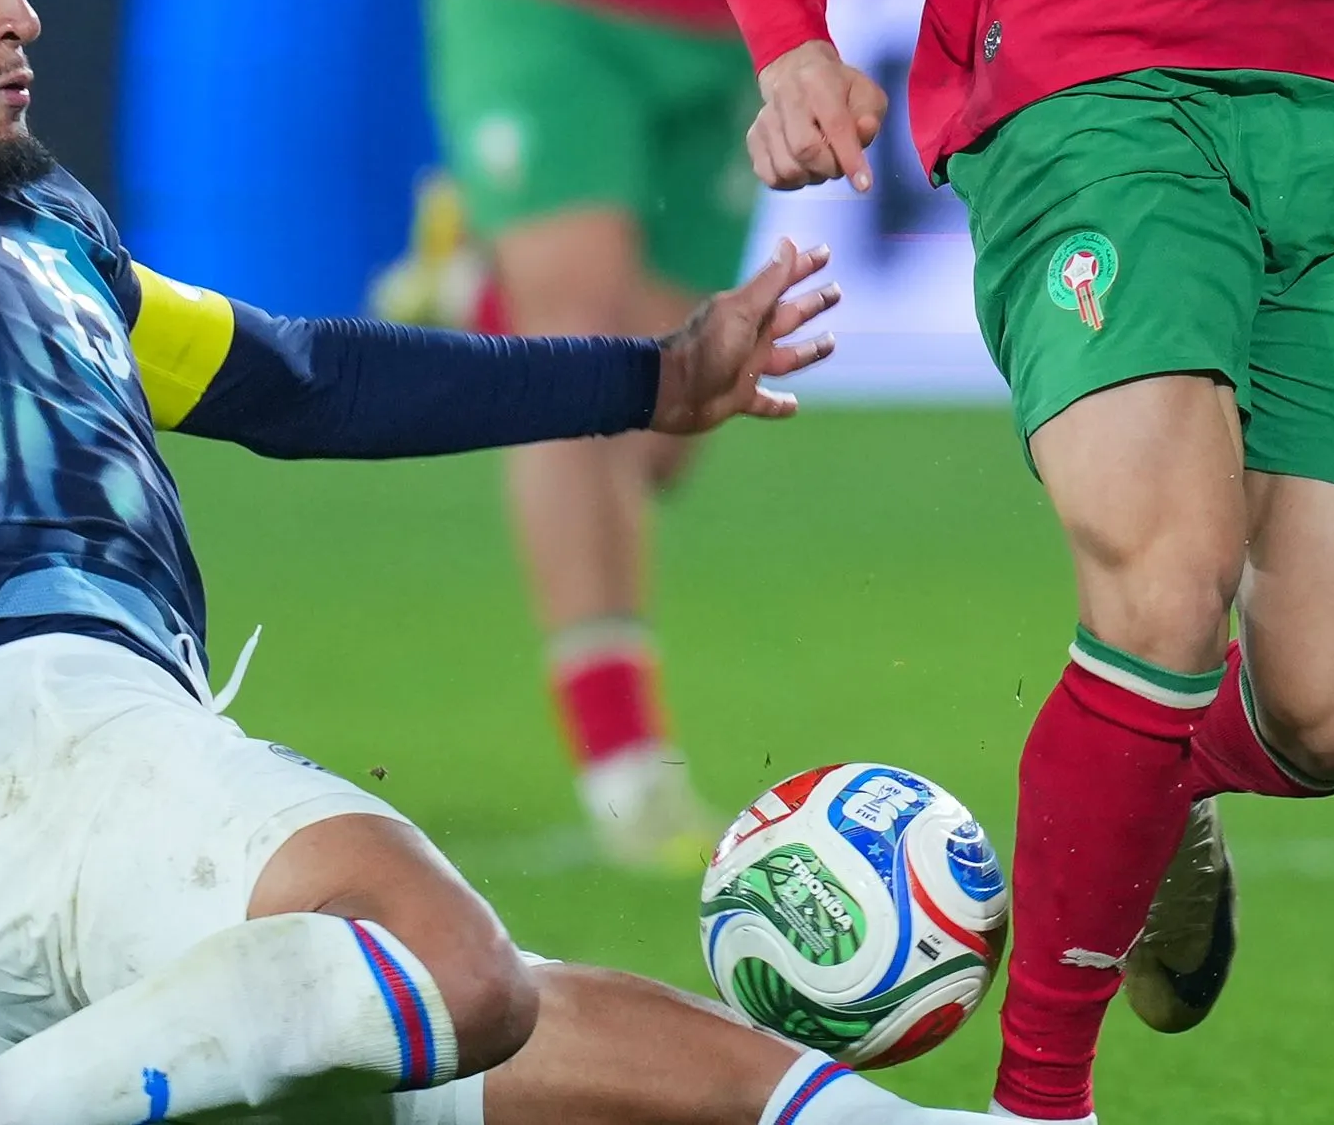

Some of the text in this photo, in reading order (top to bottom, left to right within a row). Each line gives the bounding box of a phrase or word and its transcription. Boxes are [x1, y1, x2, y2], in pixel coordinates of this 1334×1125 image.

[0, 236, 132, 380] 15
[855, 808, 877, 823] FIFA
[788, 854, 854, 931] TRIONDA
